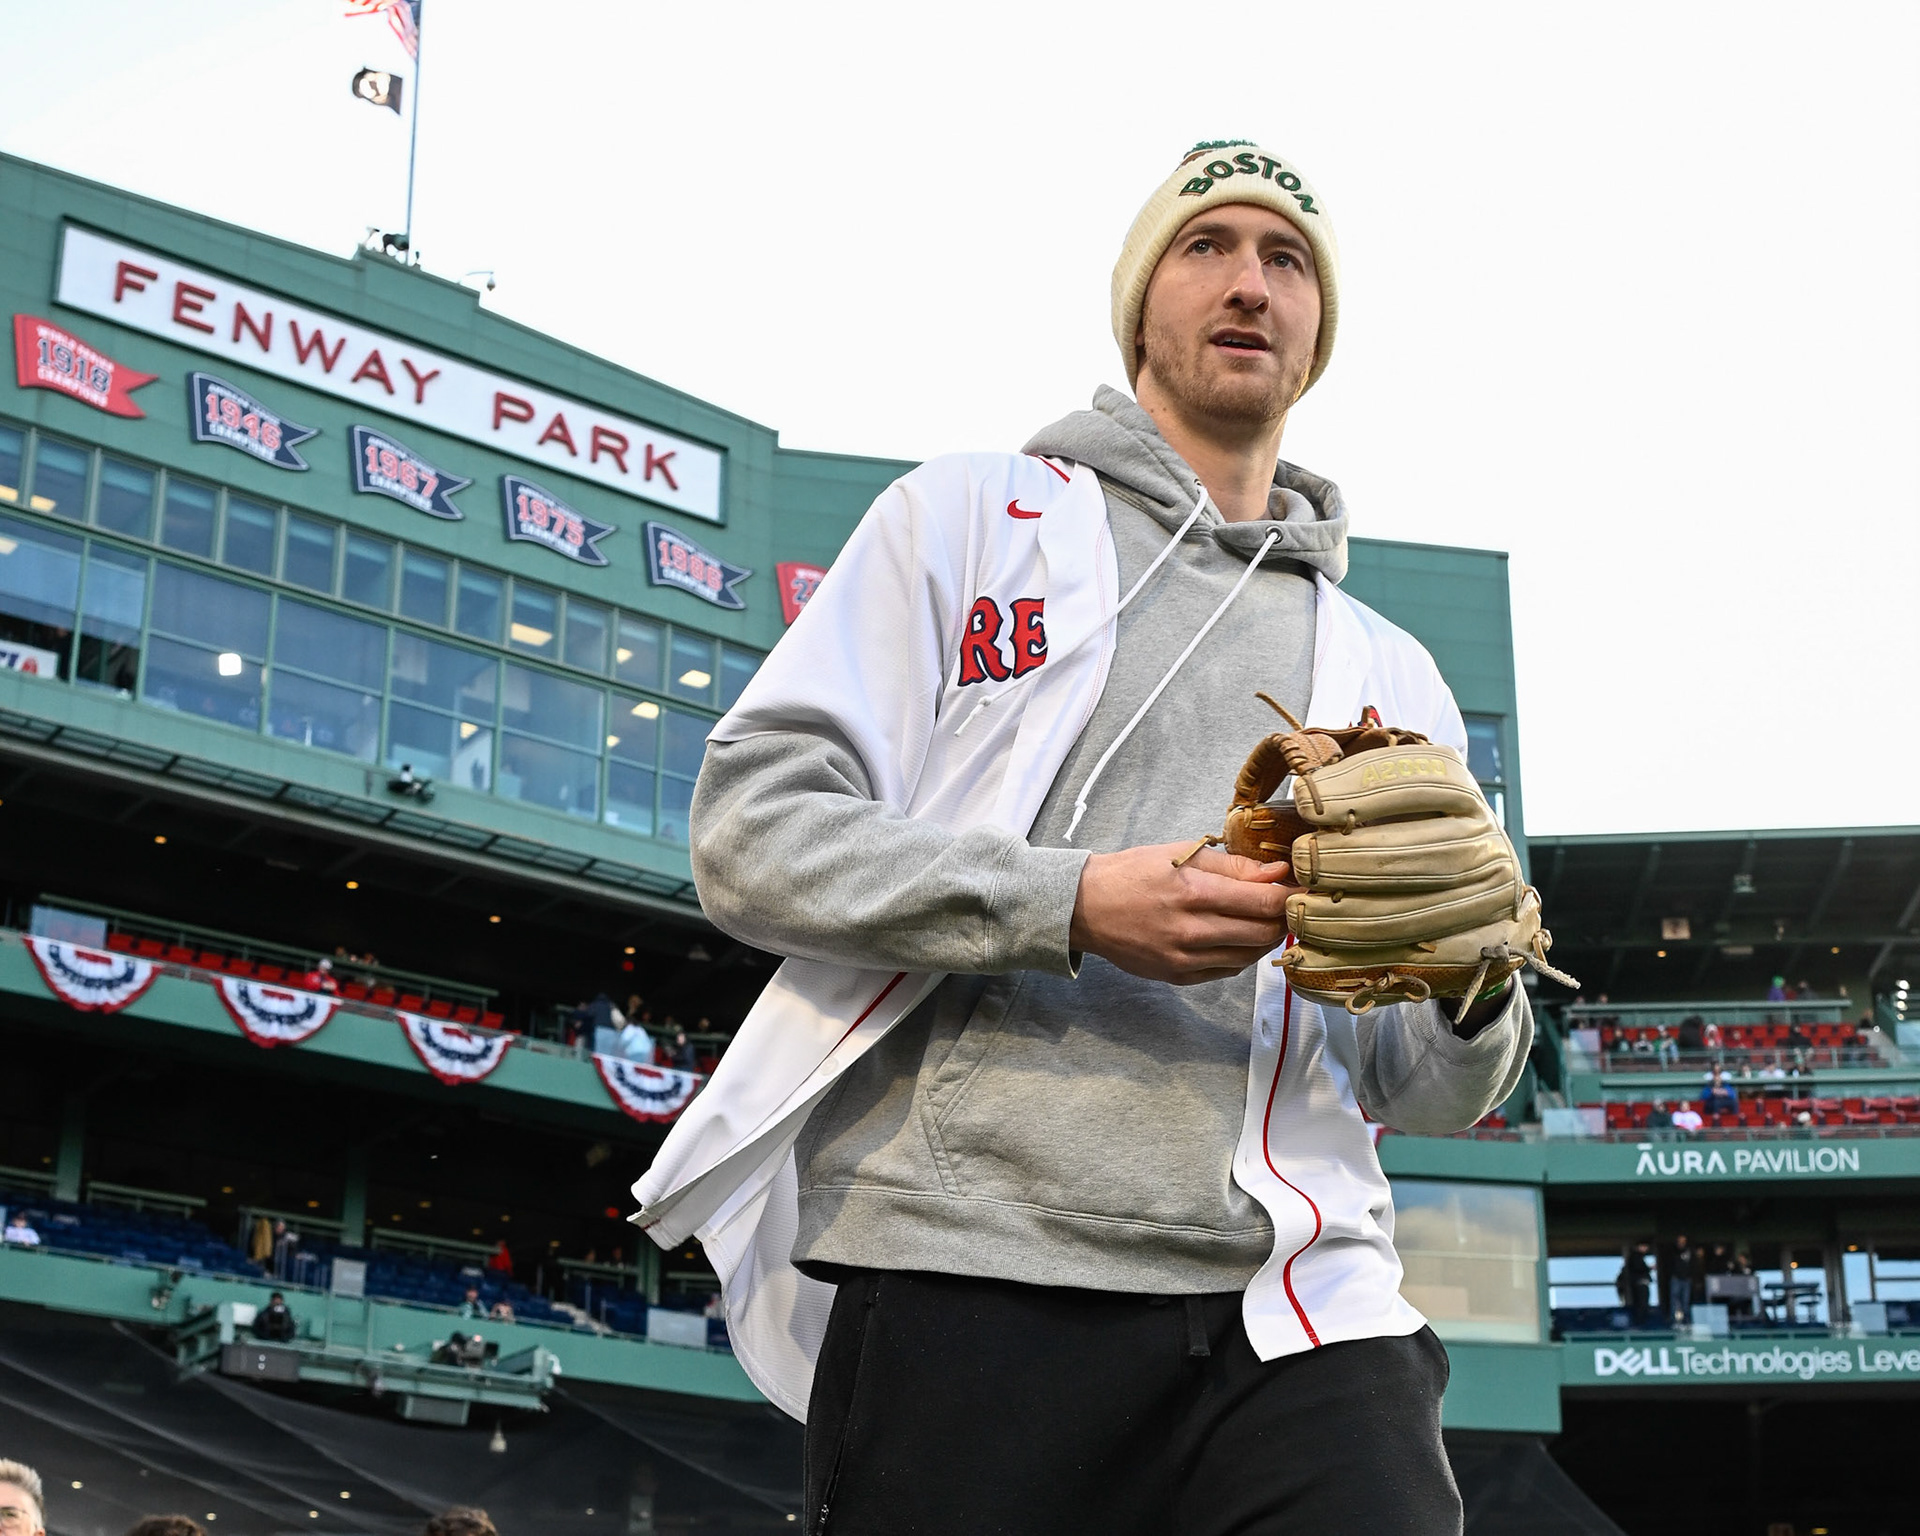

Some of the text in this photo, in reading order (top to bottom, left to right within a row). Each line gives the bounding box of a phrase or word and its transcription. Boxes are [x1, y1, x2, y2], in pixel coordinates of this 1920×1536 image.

[1178, 152, 1319, 216] BOSTON
[37, 337, 114, 395] 1918
[114, 260, 679, 491] FENWAY PARK
[205, 392, 283, 452] 1946
[365, 444, 440, 500] 1967
[516, 493, 586, 548] 1975
[1362, 758, 1447, 788] A2000
[1733, 1147, 1860, 1174] PAVILION
[1594, 1347, 1679, 1377] DELL
[1675, 1345, 1852, 1380] Technologies
